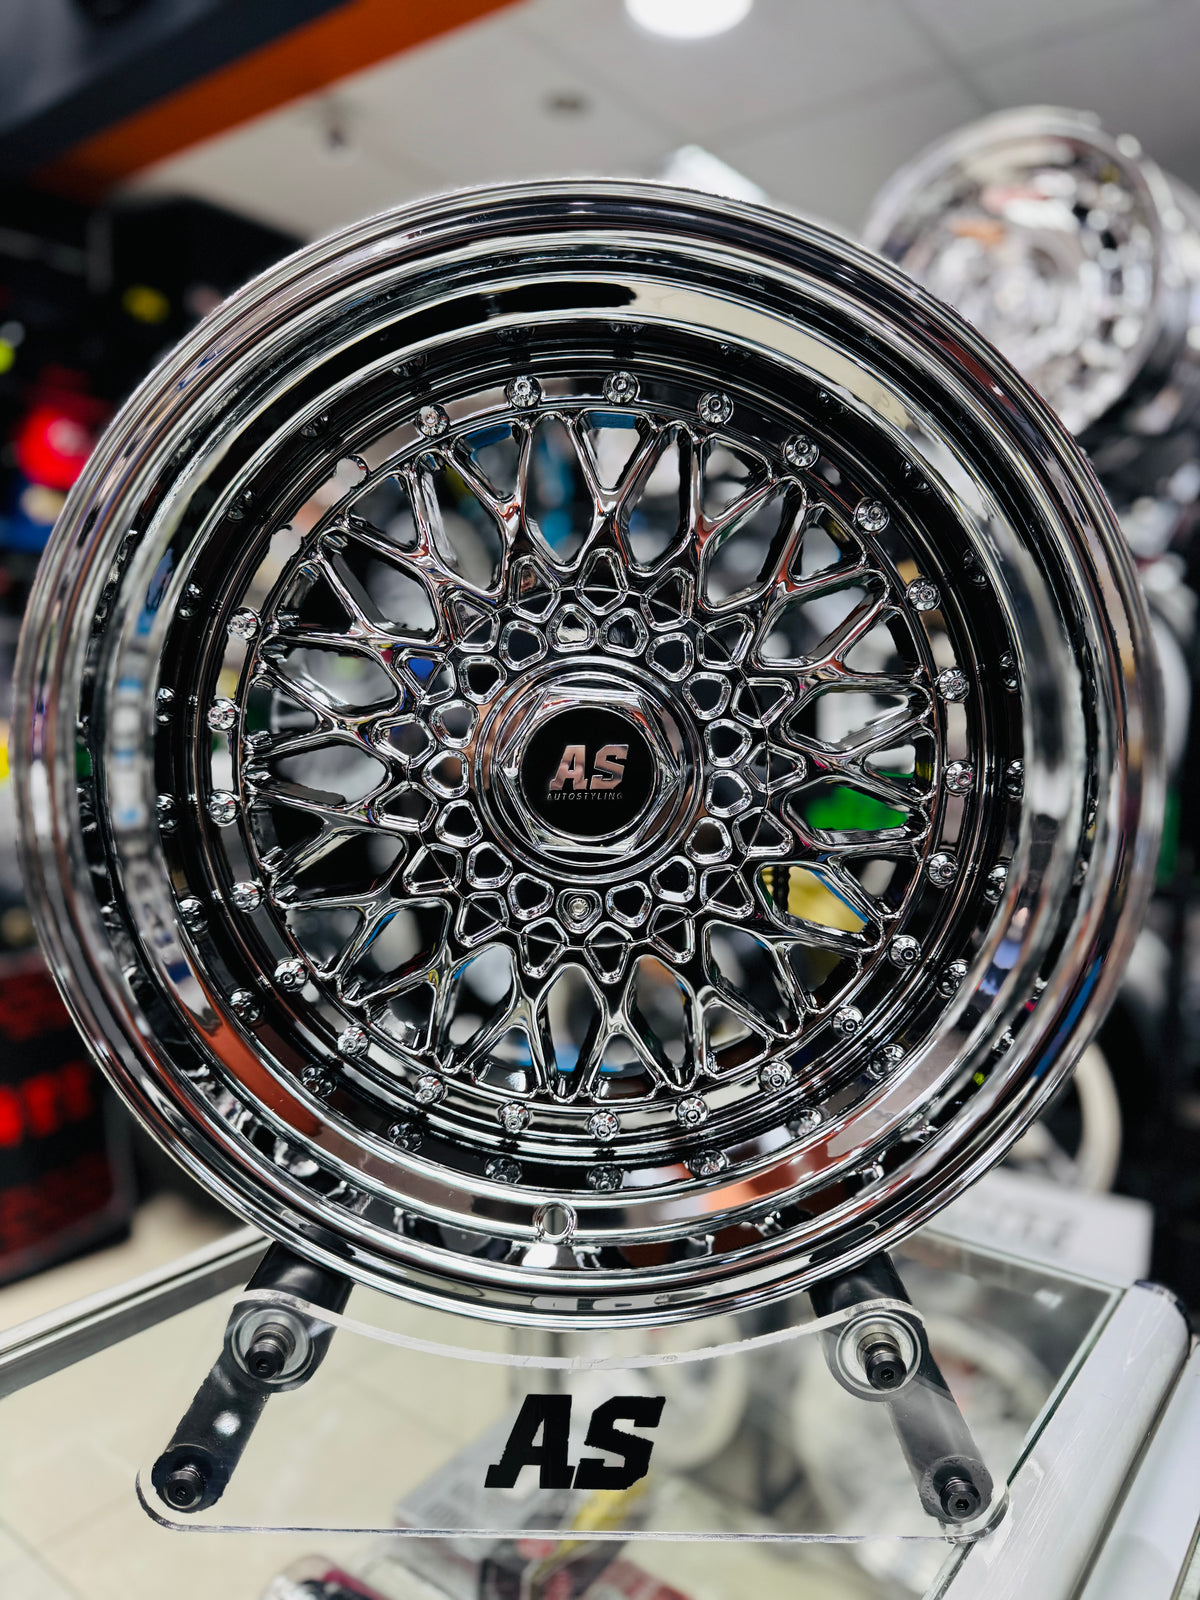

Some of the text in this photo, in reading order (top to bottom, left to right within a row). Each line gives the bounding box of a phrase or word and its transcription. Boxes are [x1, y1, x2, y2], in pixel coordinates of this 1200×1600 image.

[549, 744, 629, 790] AS
[547, 792, 623, 800] AUTOSTYLING
[484, 1394, 666, 1490] AS
